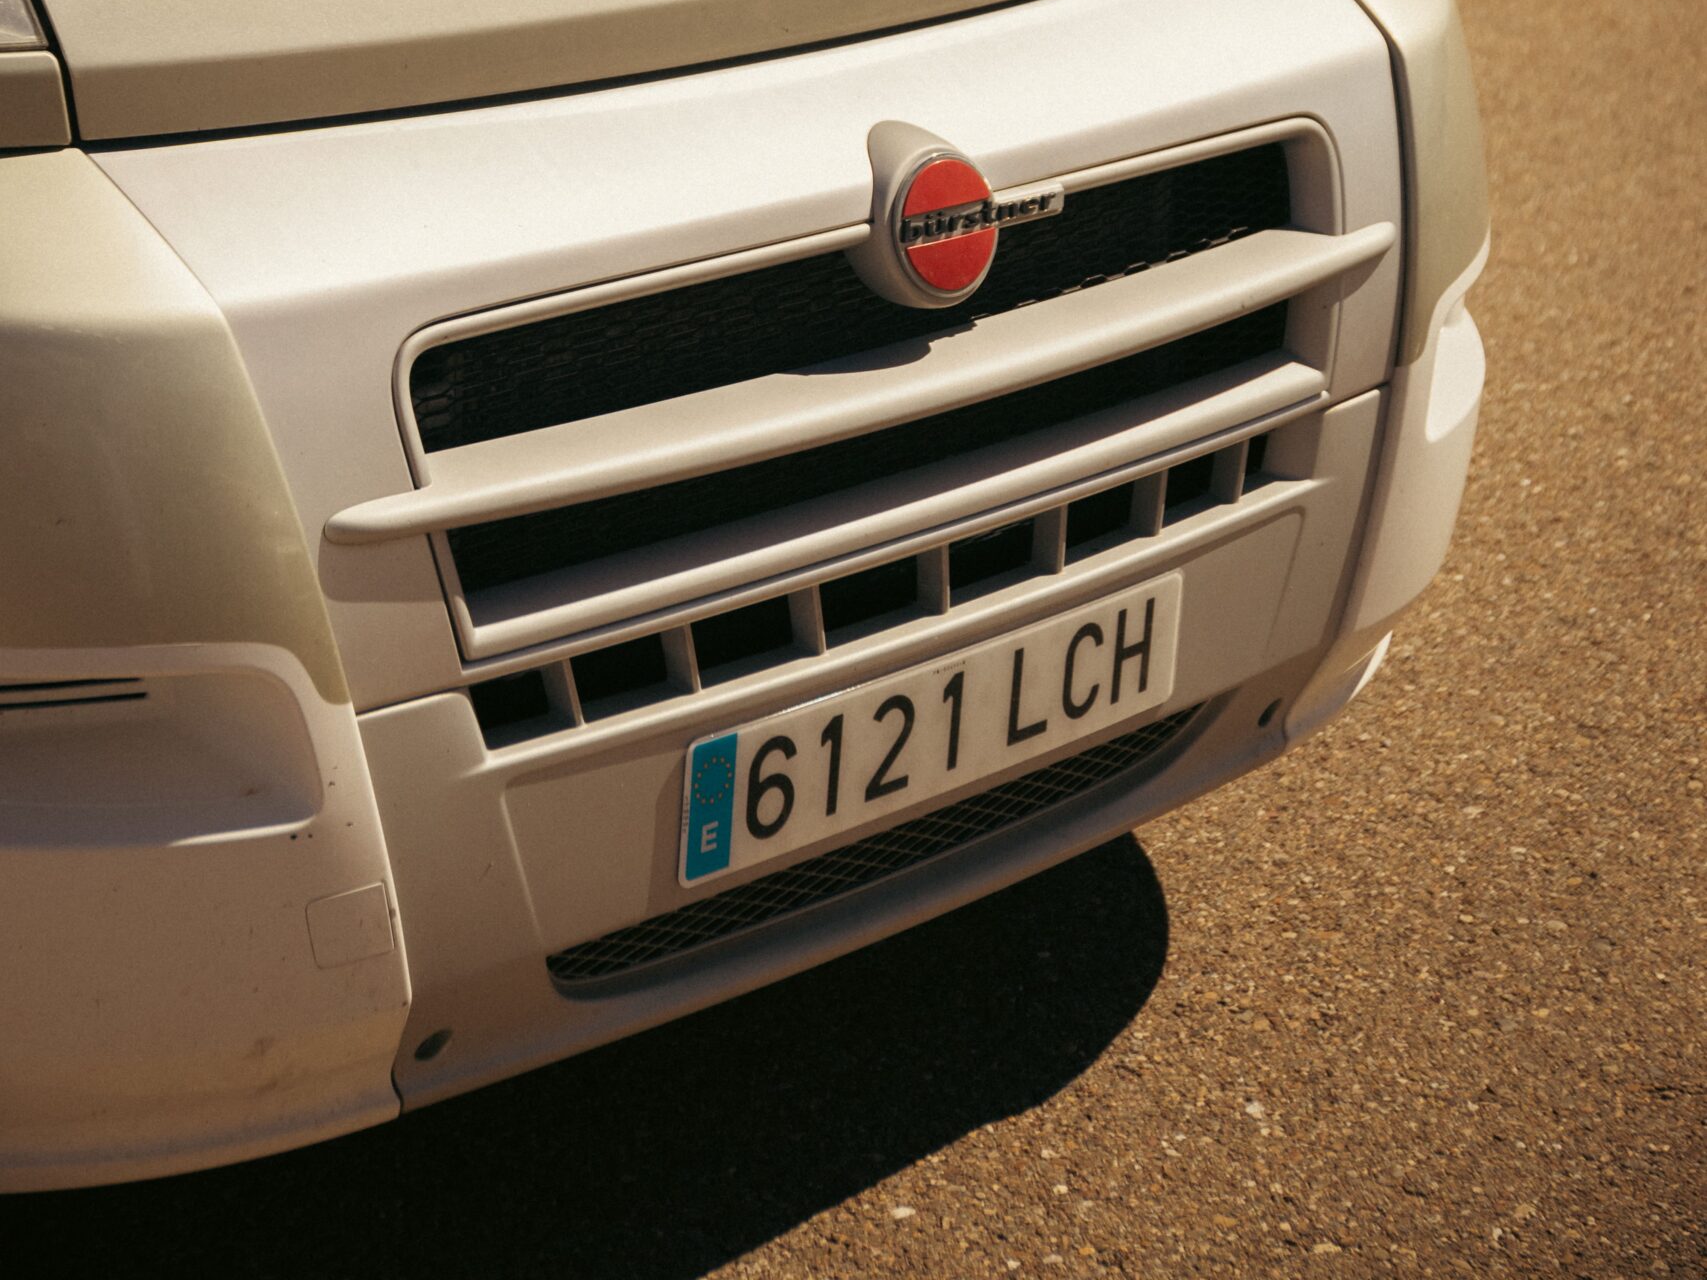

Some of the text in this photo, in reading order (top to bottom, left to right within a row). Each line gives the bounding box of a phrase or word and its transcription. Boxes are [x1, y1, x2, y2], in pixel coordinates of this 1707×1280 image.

[901, 192, 1055, 243] bürstner
[745, 597, 1155, 840] 6121 LCH
[700, 821, 718, 853] E
